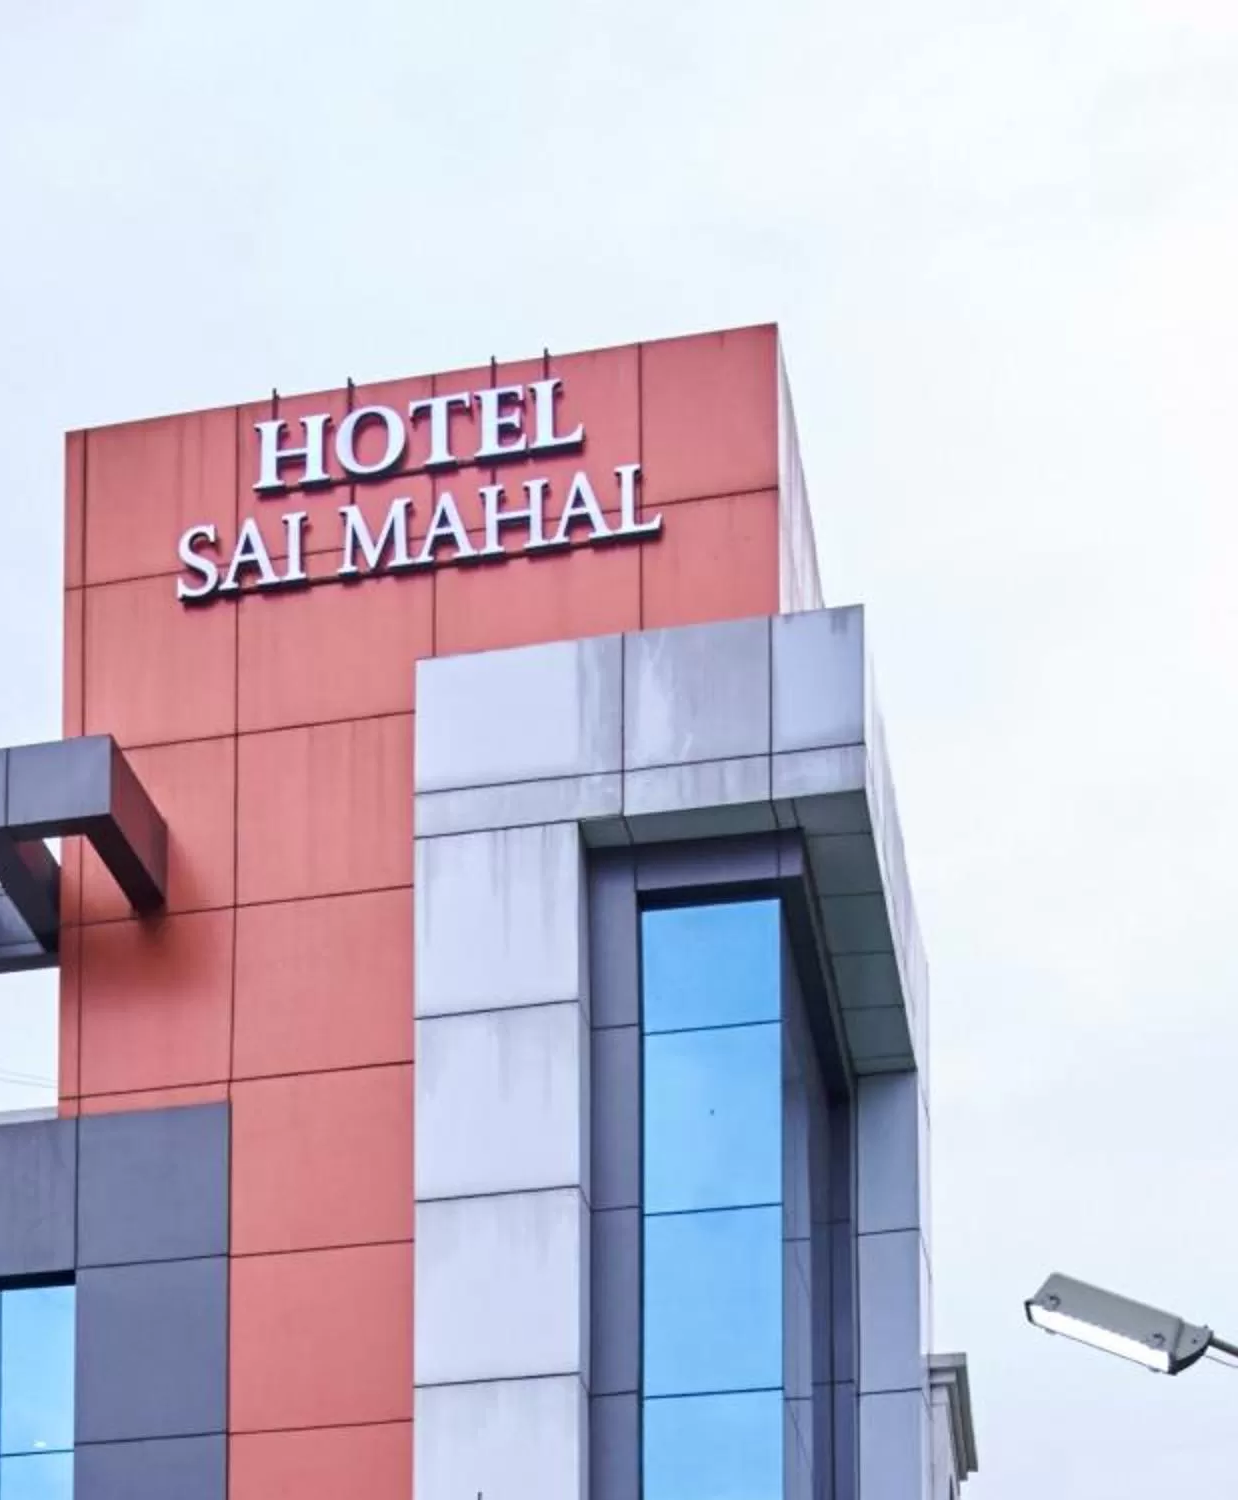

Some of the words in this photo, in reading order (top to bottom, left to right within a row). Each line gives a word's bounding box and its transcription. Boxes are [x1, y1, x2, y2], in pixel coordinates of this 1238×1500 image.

[253, 378, 585, 493] HOTEL
[176, 511, 308, 602] SAI
[336, 463, 663, 576] MAHAL
